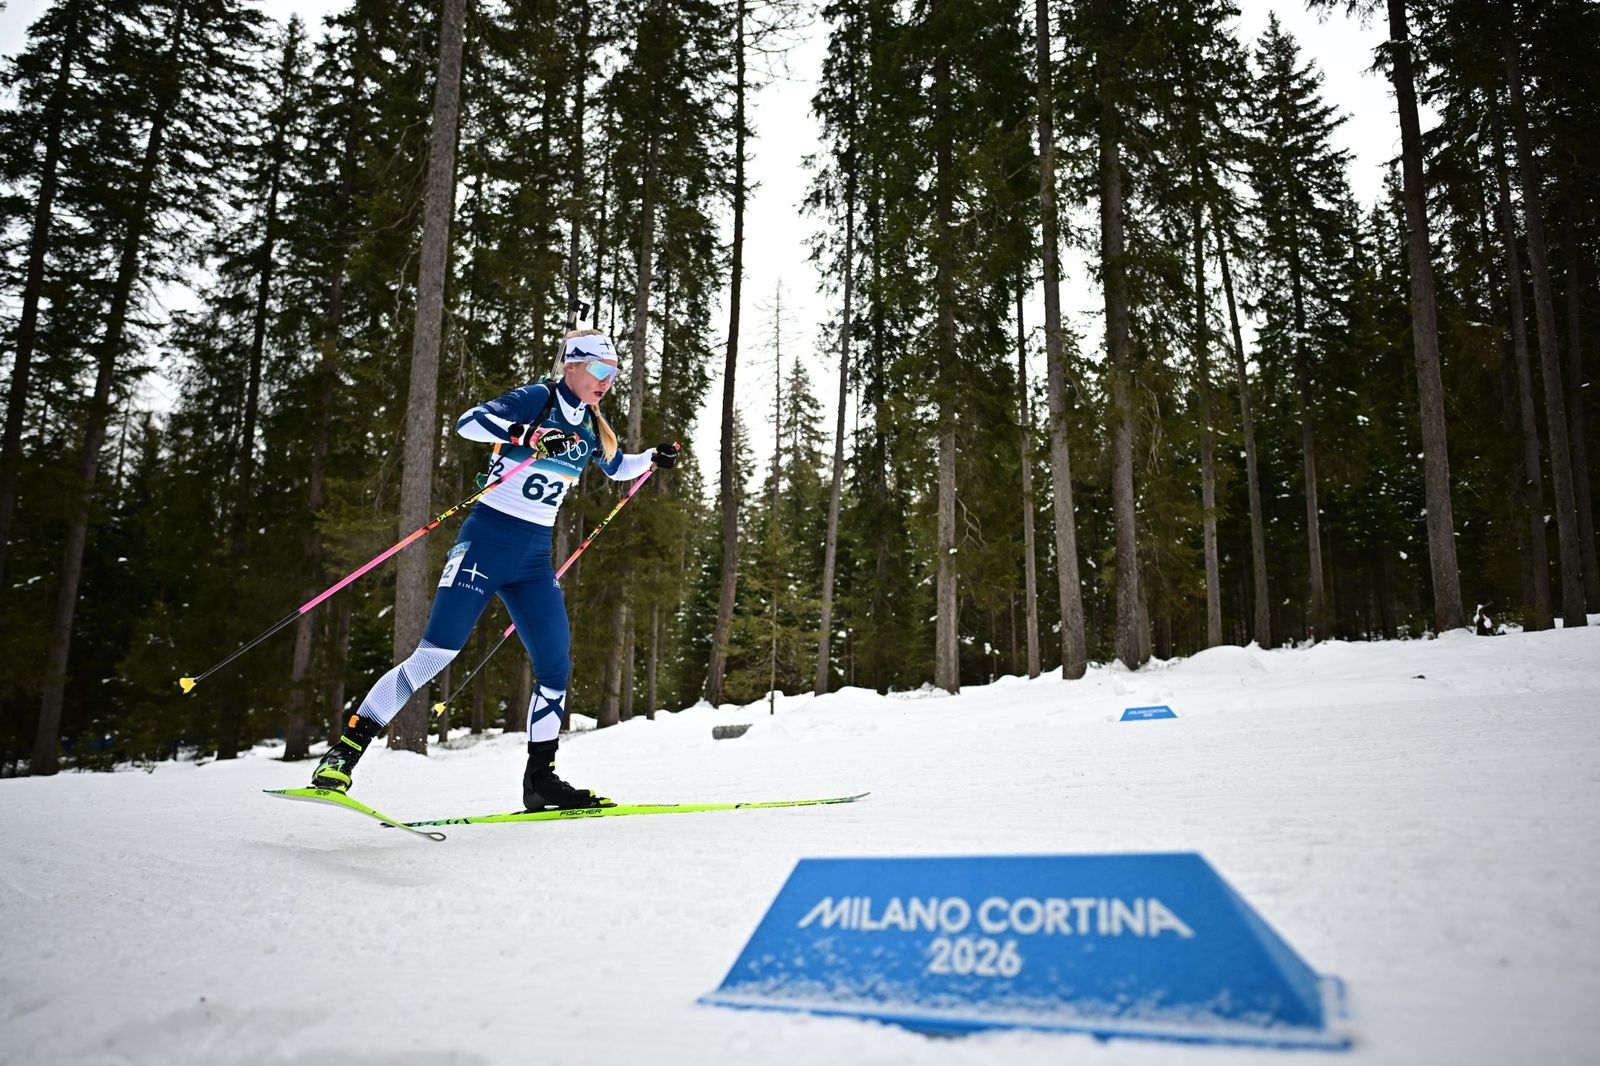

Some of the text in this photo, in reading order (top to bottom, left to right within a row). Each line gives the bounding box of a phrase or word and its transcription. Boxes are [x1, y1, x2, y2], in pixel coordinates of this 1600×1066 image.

[522, 473, 564, 507] 62
[457, 581, 485, 595] FINLAND
[560, 808, 602, 816] FISCHER
[798, 897, 1195, 939] MILANO CORTINA
[929, 939, 1022, 978] 2026
